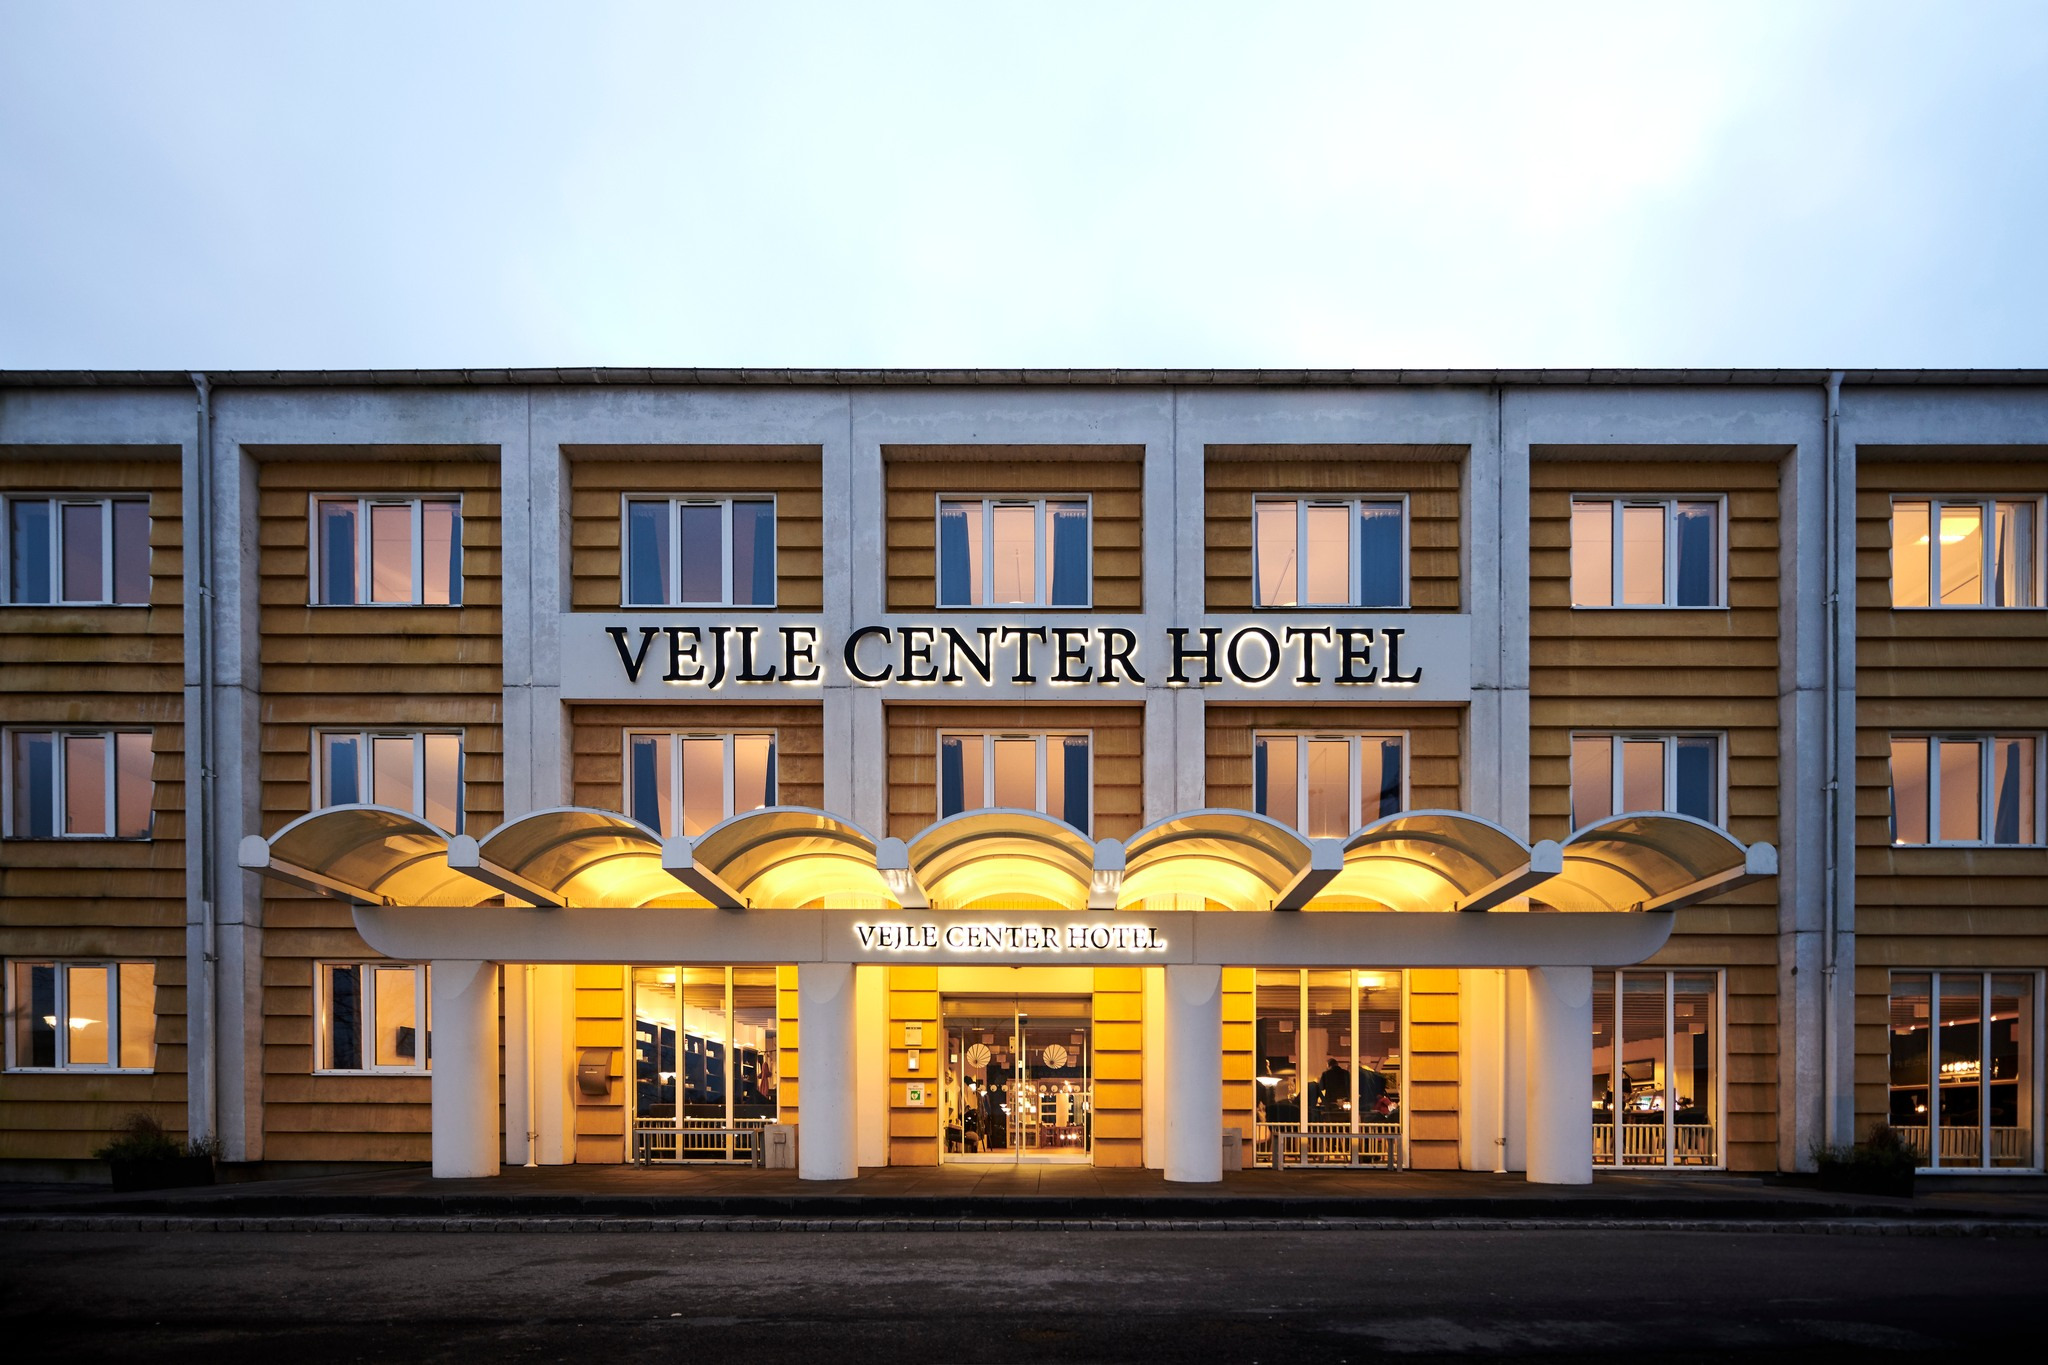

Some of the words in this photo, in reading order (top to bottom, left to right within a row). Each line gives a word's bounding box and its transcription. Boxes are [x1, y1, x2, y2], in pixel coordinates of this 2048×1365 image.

[605, 626, 821, 689] VEJLE
[843, 625, 1145, 683] CENTER
[1166, 626, 1422, 683] HOTEL
[857, 926, 938, 949] VEJLE
[946, 926, 1059, 948] CENTER
[1068, 927, 1163, 949] HOTEL
